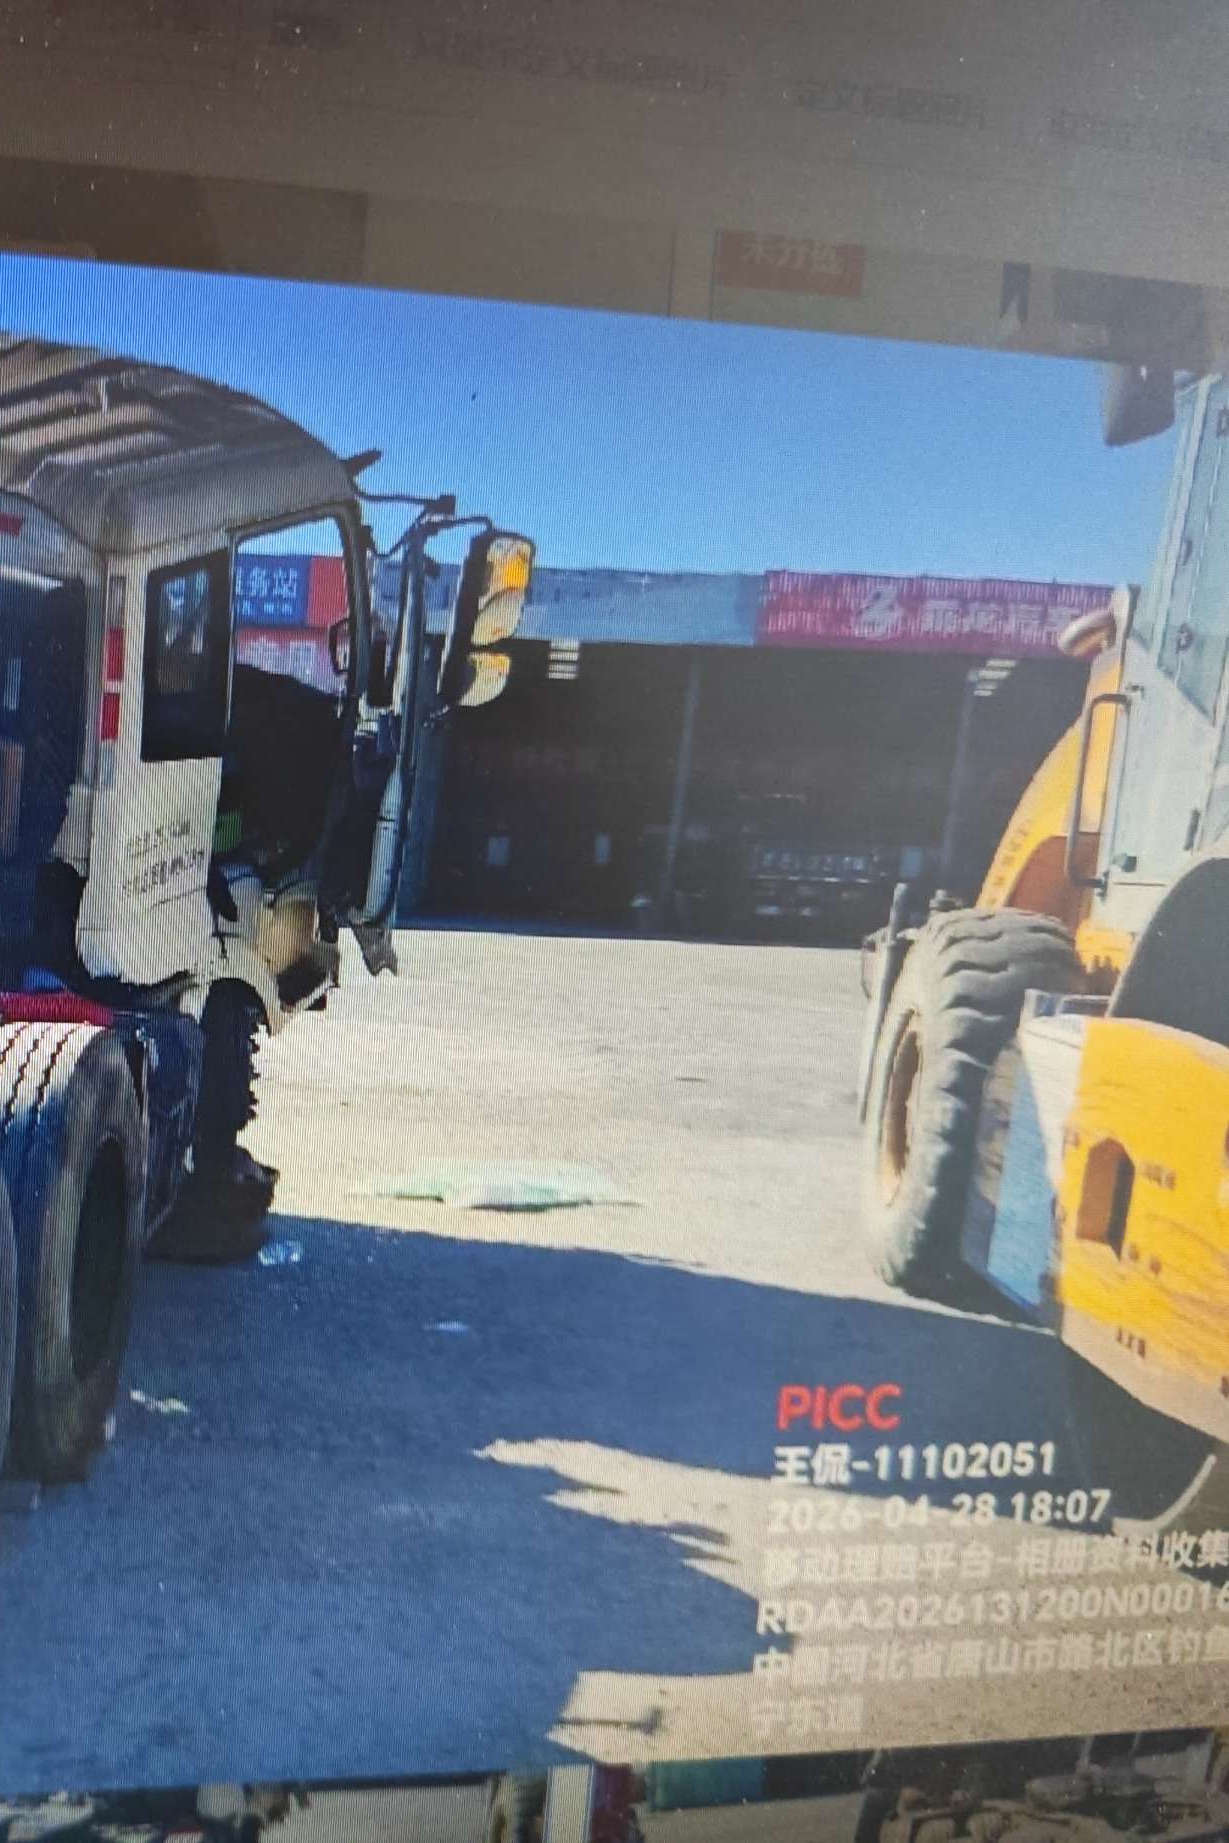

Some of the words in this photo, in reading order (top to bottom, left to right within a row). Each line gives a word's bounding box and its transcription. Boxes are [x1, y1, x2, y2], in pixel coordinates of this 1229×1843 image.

[777, 1383, 902, 1431] PICC
[773, 1441, 1056, 1485] 王侃-11102051
[767, 1492, 997, 1533] 2026-04-28
[1011, 1488, 1112, 1524] 18:07
